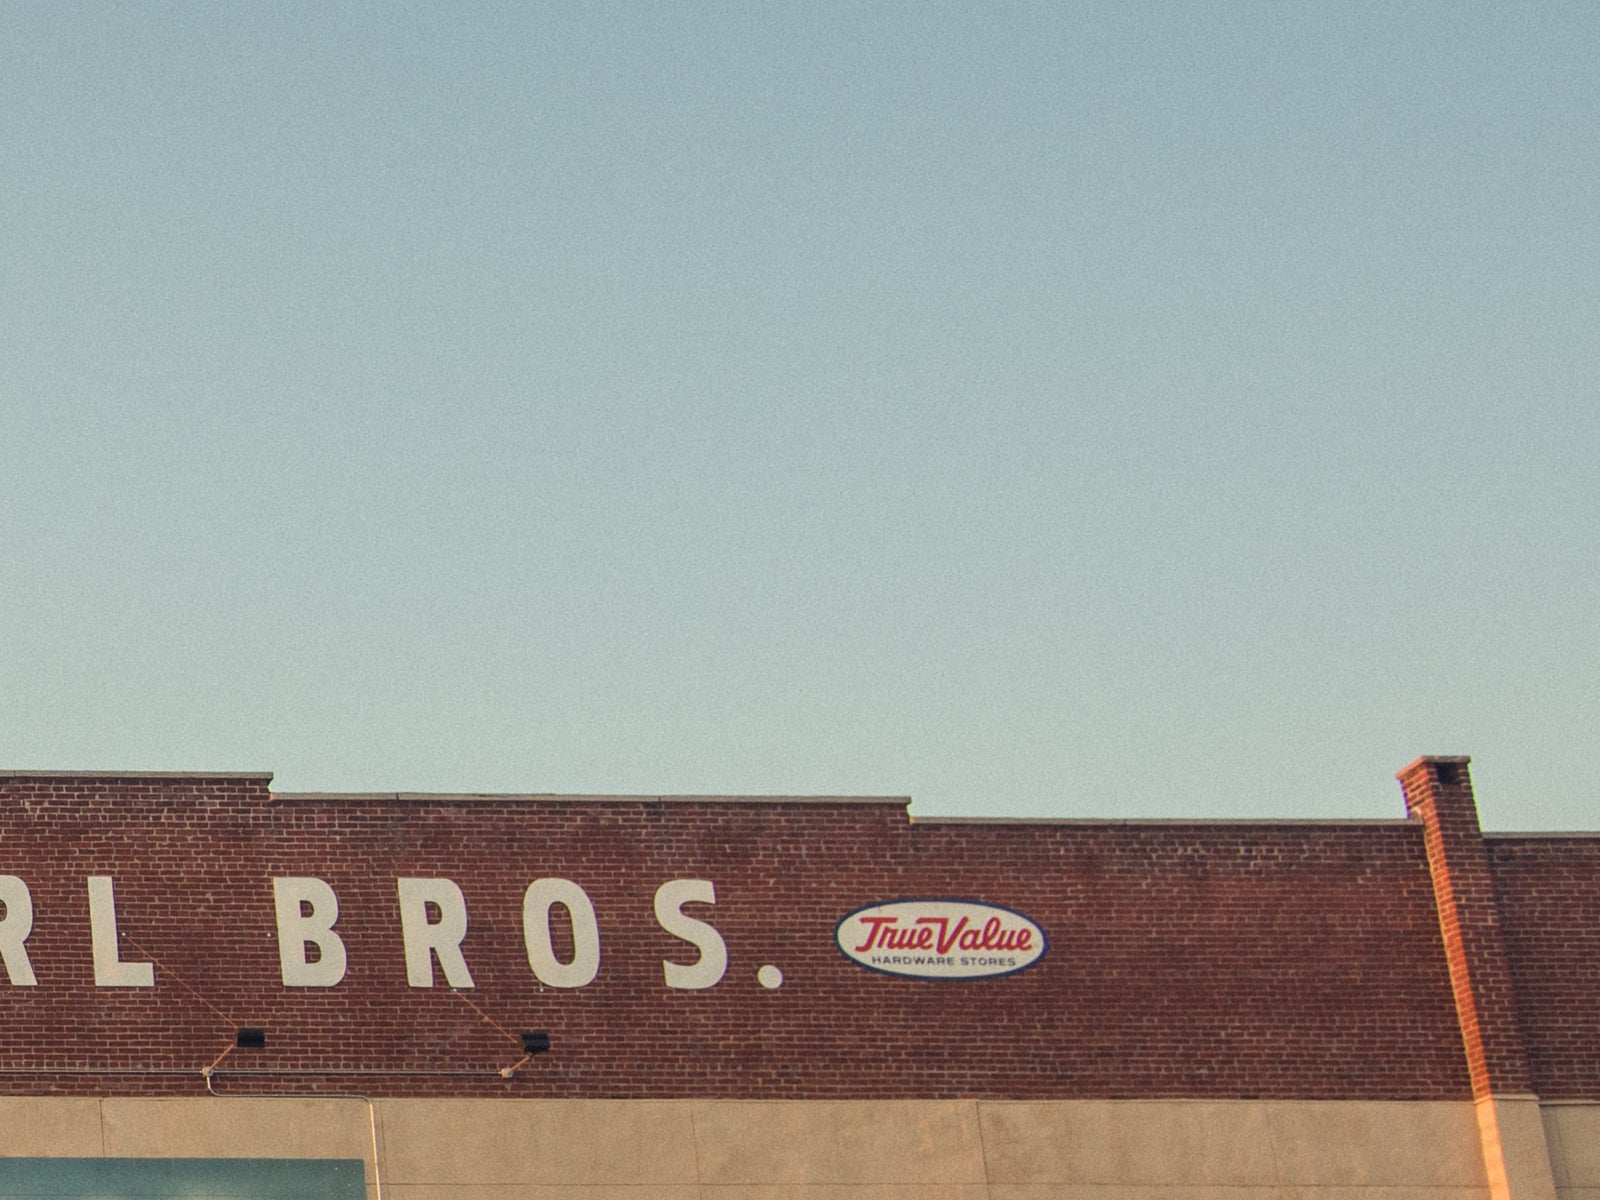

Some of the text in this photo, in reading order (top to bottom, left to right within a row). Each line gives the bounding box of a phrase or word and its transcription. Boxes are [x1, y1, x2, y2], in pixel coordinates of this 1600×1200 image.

[273, 877, 783, 989] BROS.
[871, 955, 1017, 967] HARDWARE STORES
